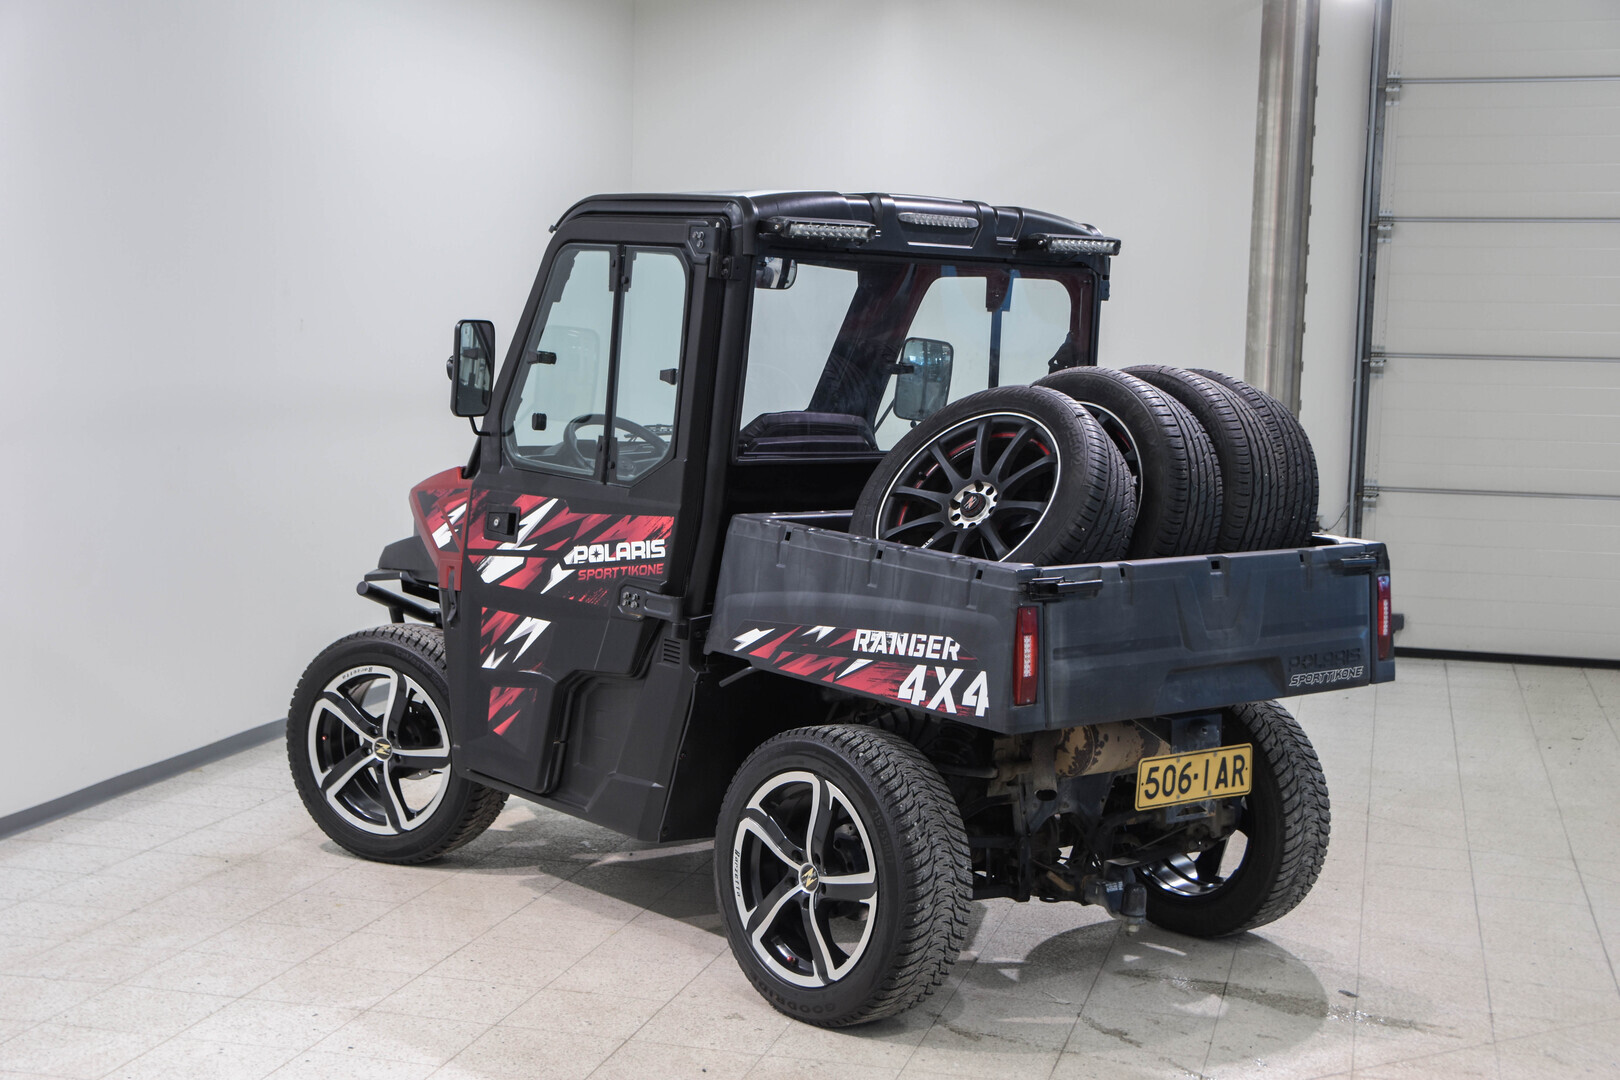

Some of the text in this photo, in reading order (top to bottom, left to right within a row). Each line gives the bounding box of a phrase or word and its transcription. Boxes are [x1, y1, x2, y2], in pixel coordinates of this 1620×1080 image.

[572, 539, 666, 564] POLARIS
[578, 563, 664, 581] SPORTTIKONE
[853, 628, 961, 661] RANGER
[1288, 648, 1361, 673] POLARIS
[1289, 665, 1364, 687] SPORTTIKONE
[897, 664, 990, 717] 4X4
